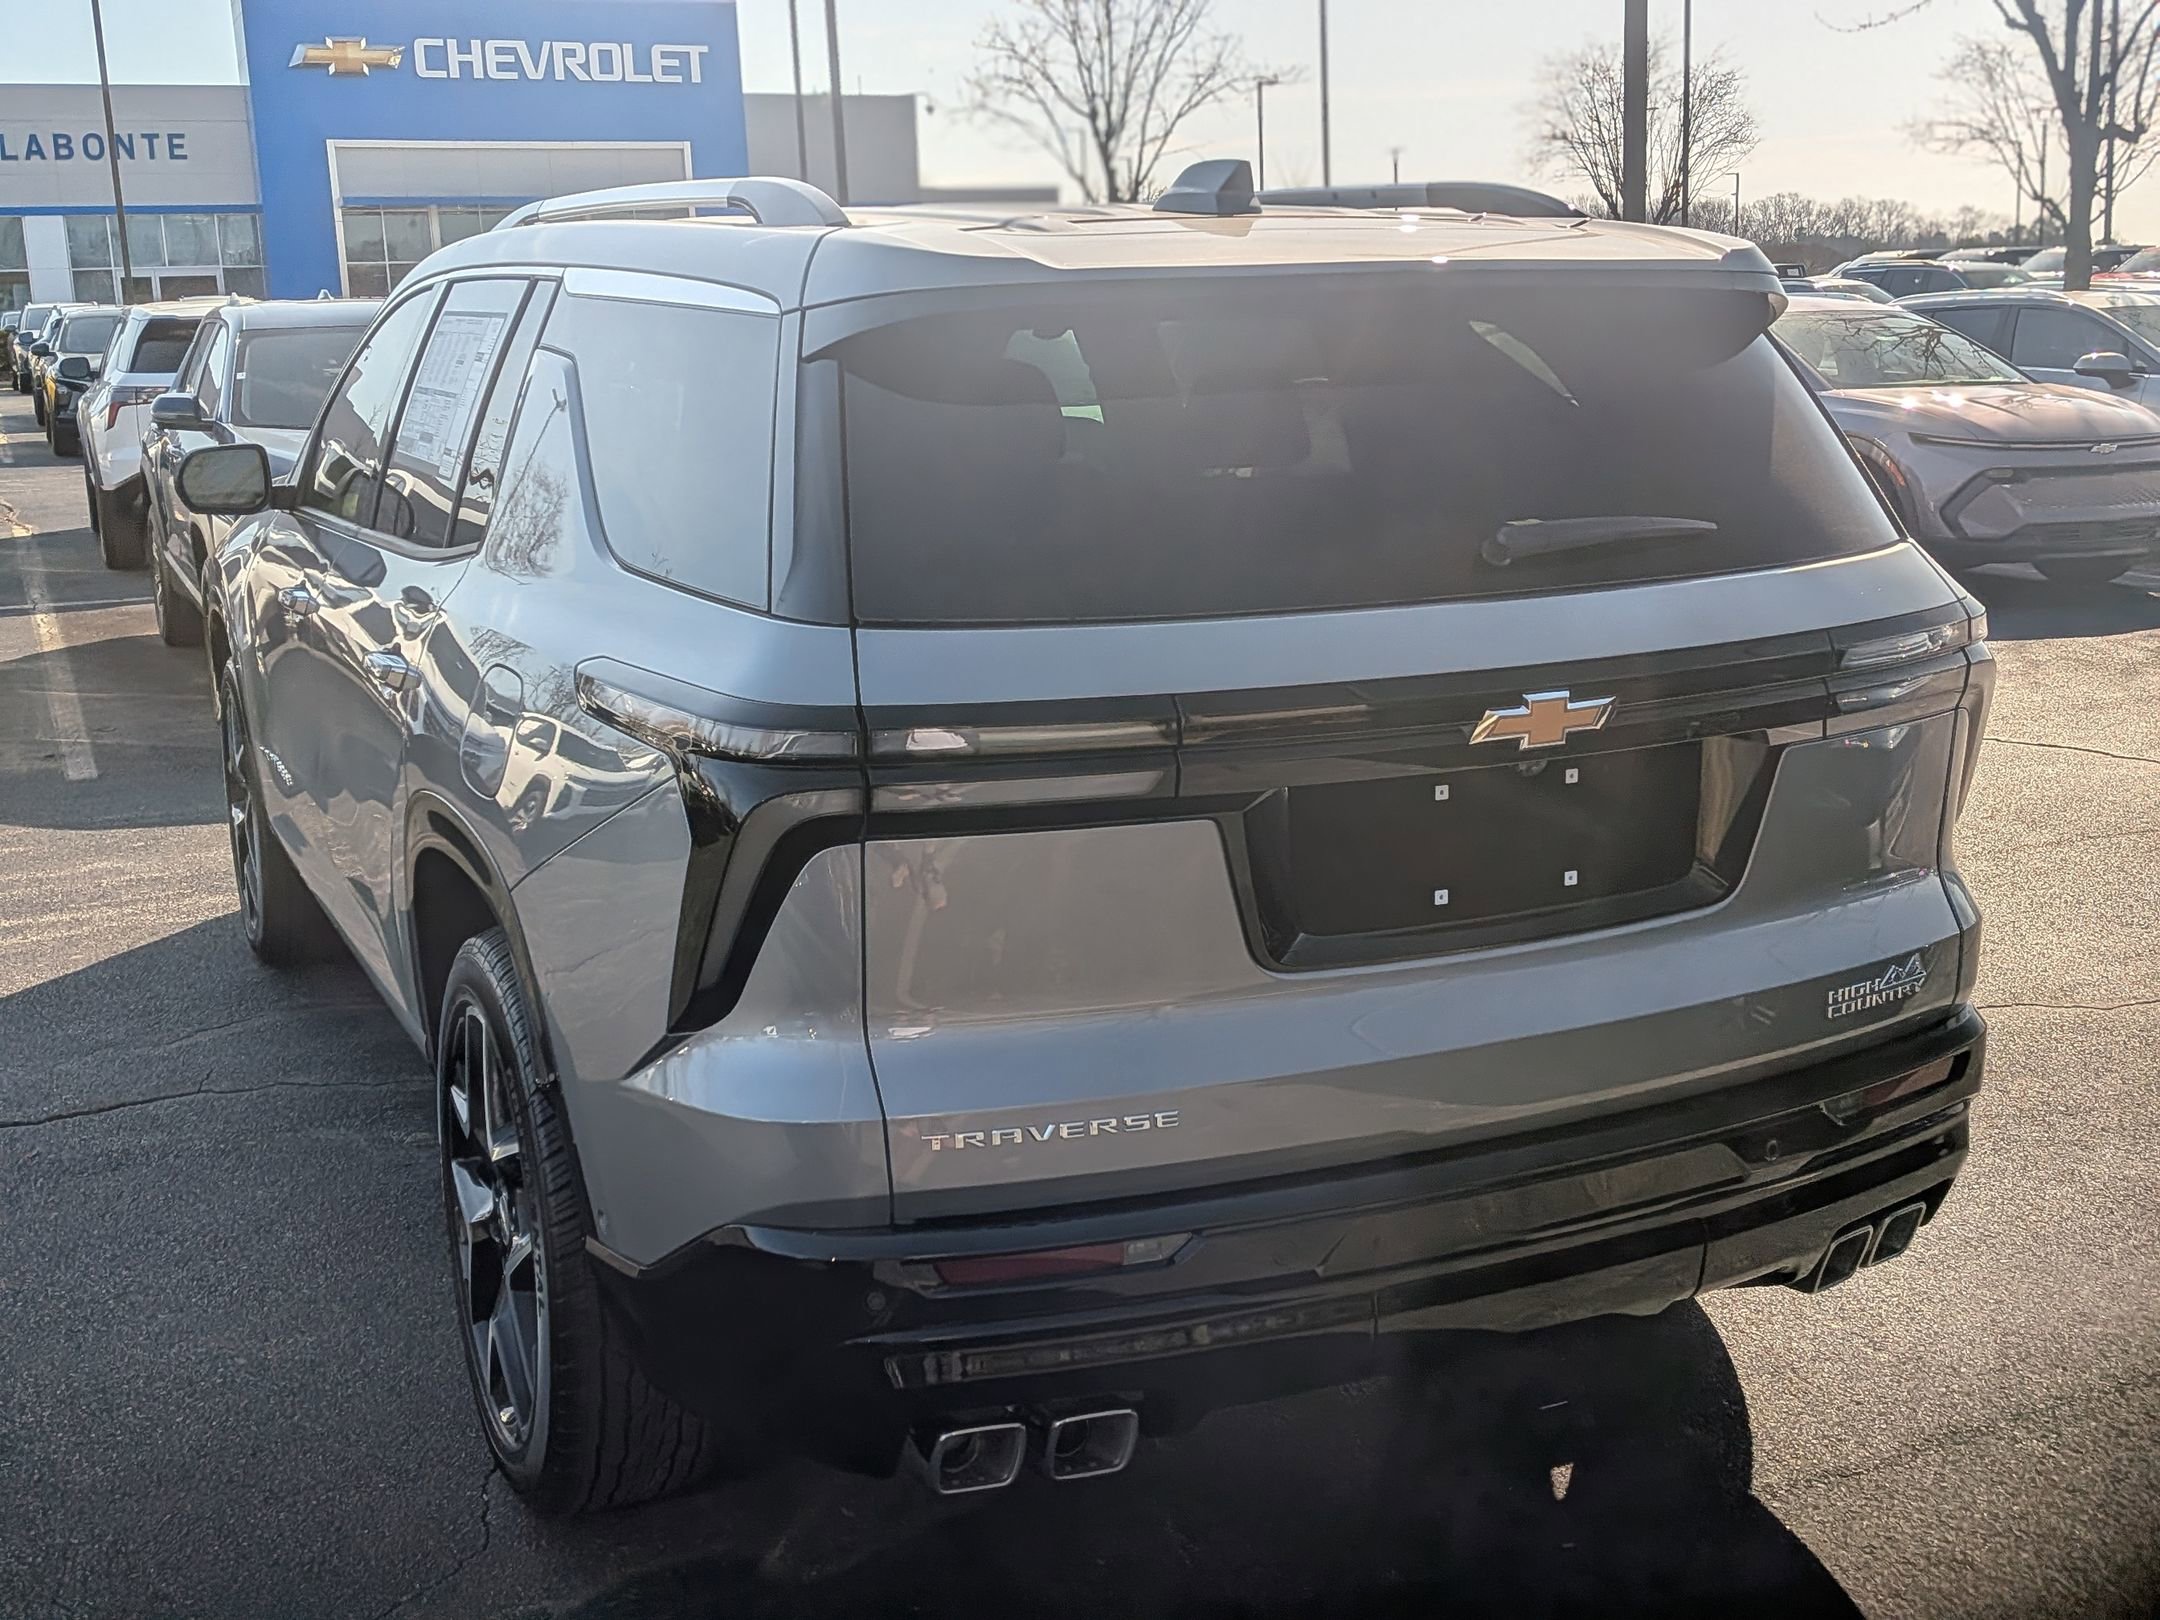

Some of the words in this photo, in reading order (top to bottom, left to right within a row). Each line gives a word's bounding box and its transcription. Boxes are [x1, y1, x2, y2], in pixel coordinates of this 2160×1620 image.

[413, 38, 709, 83] CHEVROLET
[0, 133, 188, 161] LABONTE
[1827, 977, 1926, 1019] COUNTRY
[1828, 978, 1882, 1005] HIGH
[921, 1110, 1180, 1151] TRAVERSE
